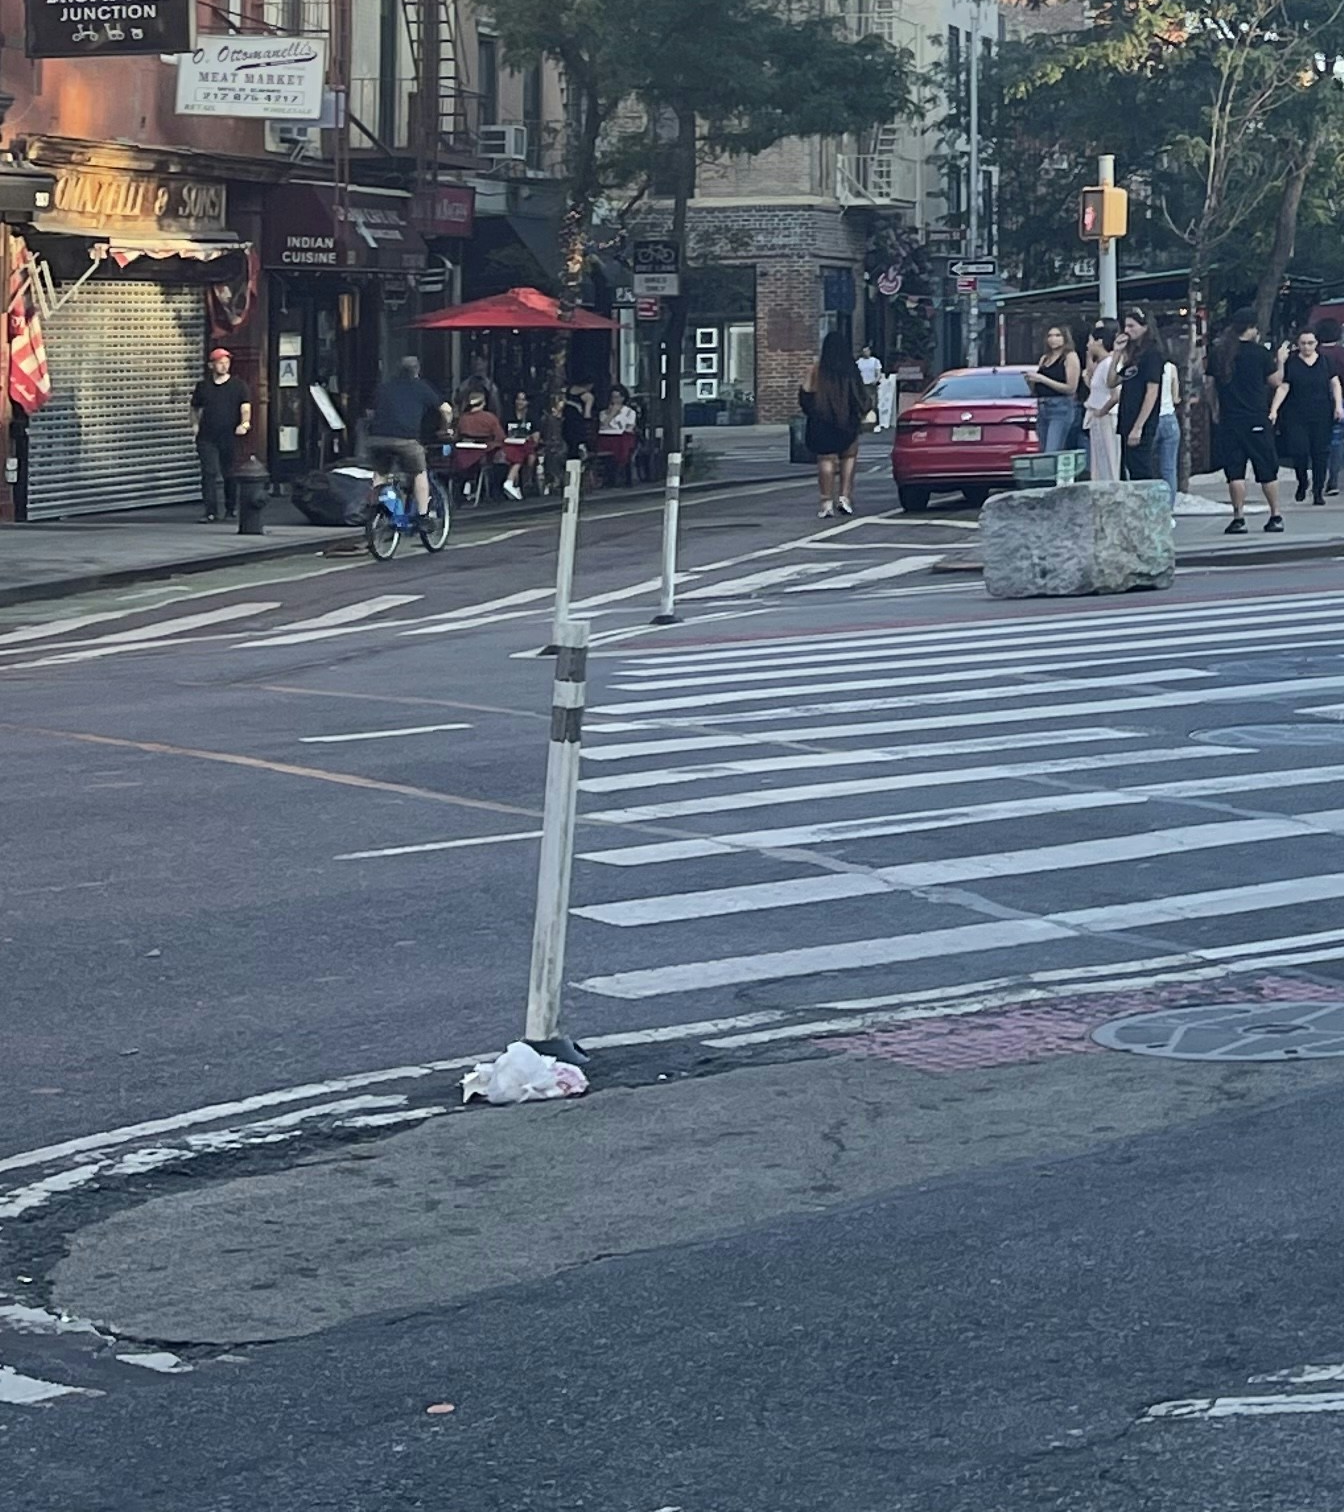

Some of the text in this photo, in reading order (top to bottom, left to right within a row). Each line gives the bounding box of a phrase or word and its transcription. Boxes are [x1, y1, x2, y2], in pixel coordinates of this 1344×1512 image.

[60, 4, 157, 22] JUNCTION
[198, 71, 305, 86] MEAT MARKET
[178, 184, 220, 218] SONS
[287, 236, 335, 249] INDIAN
[281, 251, 337, 265] CUISINE
